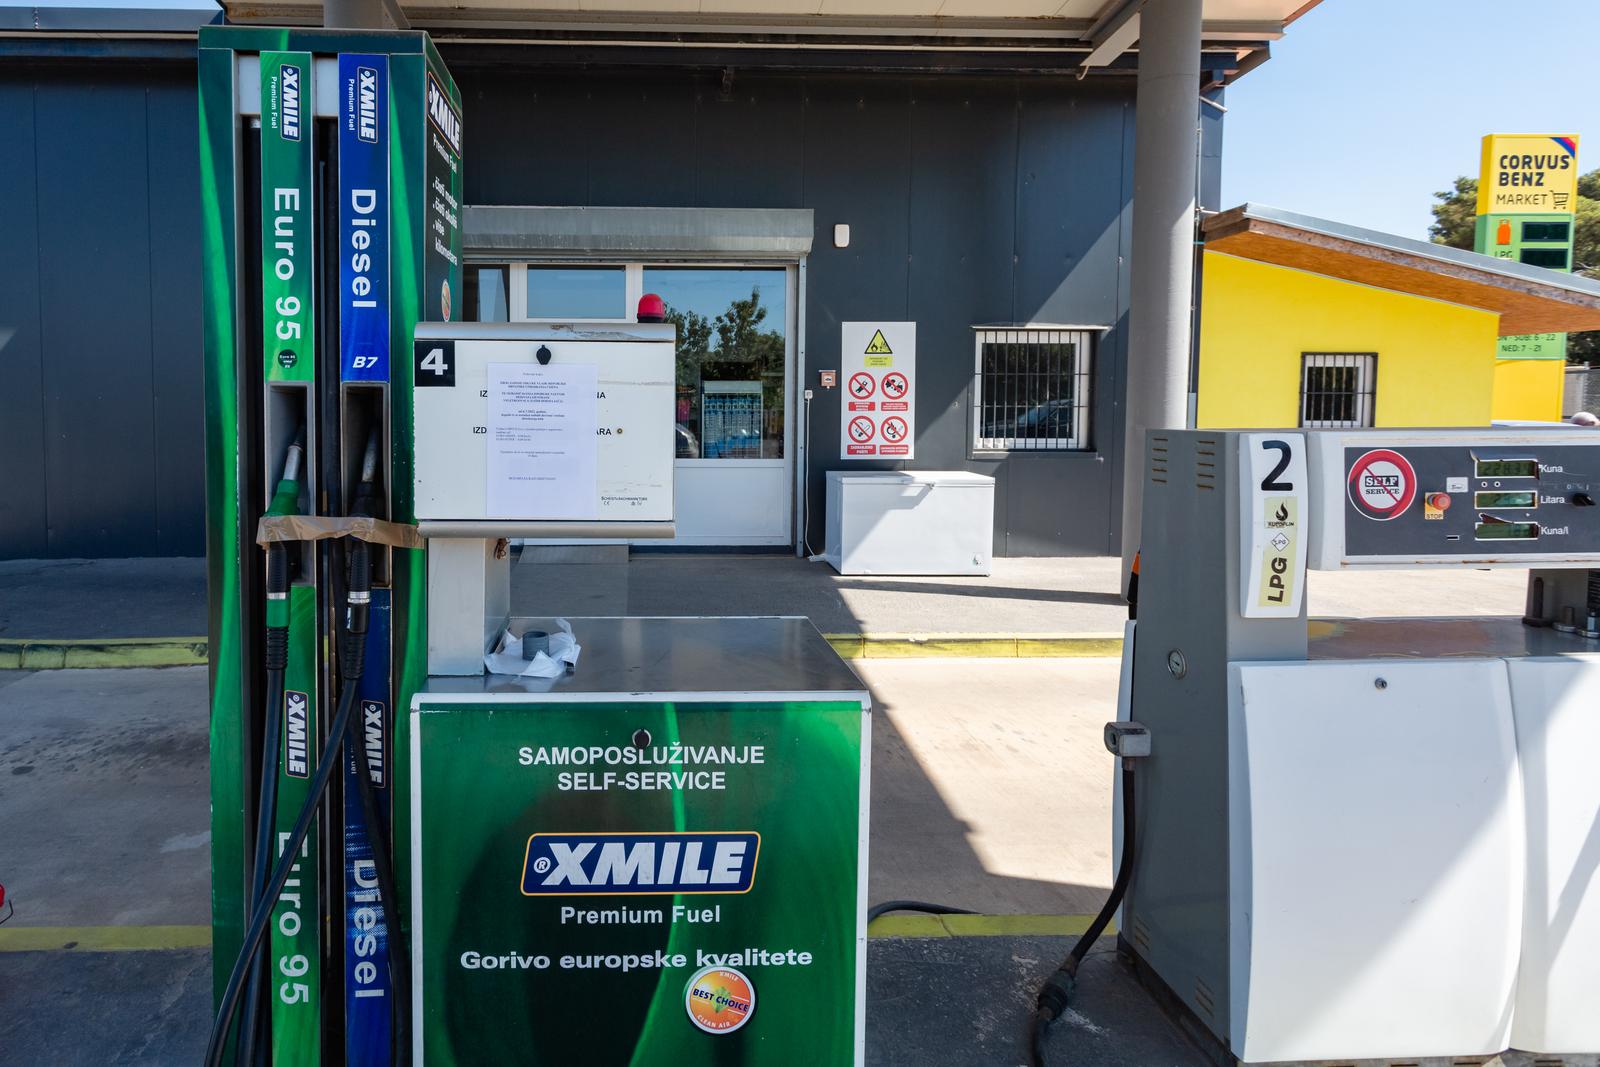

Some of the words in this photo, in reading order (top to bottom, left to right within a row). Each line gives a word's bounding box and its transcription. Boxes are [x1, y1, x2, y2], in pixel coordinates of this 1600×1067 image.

[283, 71, 298, 138] XMILE
[361, 73, 375, 138] XMILE
[430, 82, 460, 151] XMILE
[1500, 155, 1570, 170] CORVUS
[1499, 172, 1544, 186] BENZ
[1496, 194, 1548, 205] MARKET
[274, 188, 300, 280] Euro
[352, 190, 376, 308] Diesel
[276, 296, 300, 340] 95
[352, 356, 378, 368] B7
[420, 348, 448, 376] 4
[1261, 440, 1293, 491] 2
[1540, 464, 1563, 473] Kuna
[1366, 477, 1398, 486] SELF
[1541, 526, 1568, 535] Kuna/l
[1268, 557, 1287, 602] LPG
[288, 698, 306, 774] XMILE
[364, 708, 382, 783] XMILE
[518, 742, 765, 766] SAMOPOSLUŽIVANJE
[557, 771, 726, 791] SELF-SERVICE
[541, 841, 748, 886] XMILE
[560, 906, 664, 925] Premium
[672, 904, 720, 924] Fuel
[354, 860, 384, 998] Diesel
[460, 951, 550, 969] Gorivo
[560, 950, 687, 972] europske
[696, 949, 813, 968] kvalitete
[280, 954, 309, 1004] 95
[692, 988, 714, 1000] BEST
[716, 996, 749, 1012] CHOICE
[697, 1014, 716, 1028] CLEAN
